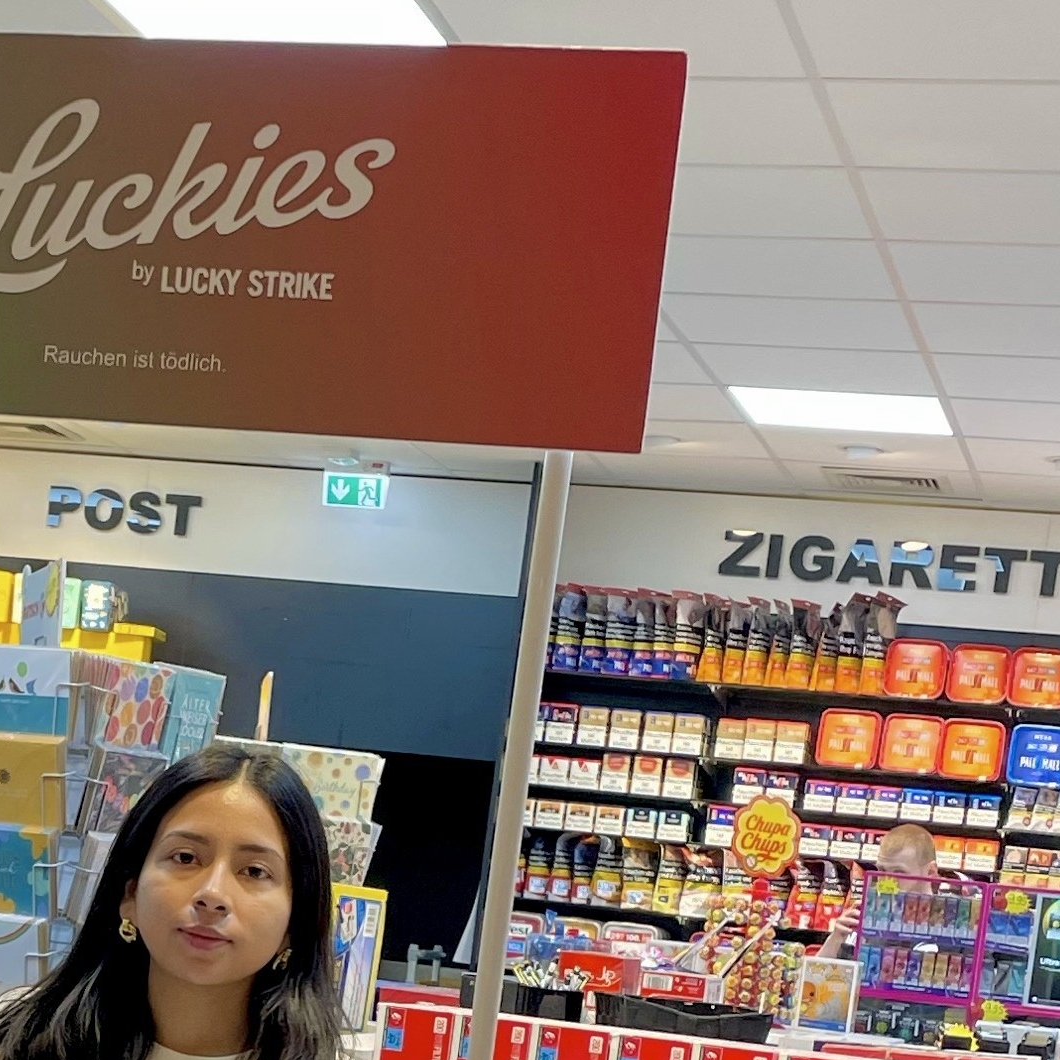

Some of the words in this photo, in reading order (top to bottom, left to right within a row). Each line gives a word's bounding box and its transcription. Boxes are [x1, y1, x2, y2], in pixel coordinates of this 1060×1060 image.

[131, 260, 155, 286] by
[160, 265, 242, 297] LUCKY
[246, 269, 335, 301] STRIKE
[43, 344, 127, 369] Rauchen
[133, 349, 154, 369] ist
[159, 350, 227, 373] tödlich.
[46, 485, 203, 537] POST
[1019, 756, 1036, 768] PALL
[1042, 758, 1060, 771] MALL
[745, 814, 791, 836] Chupa
[741, 831, 787, 854] Chups
[511, 925, 529, 935] est
